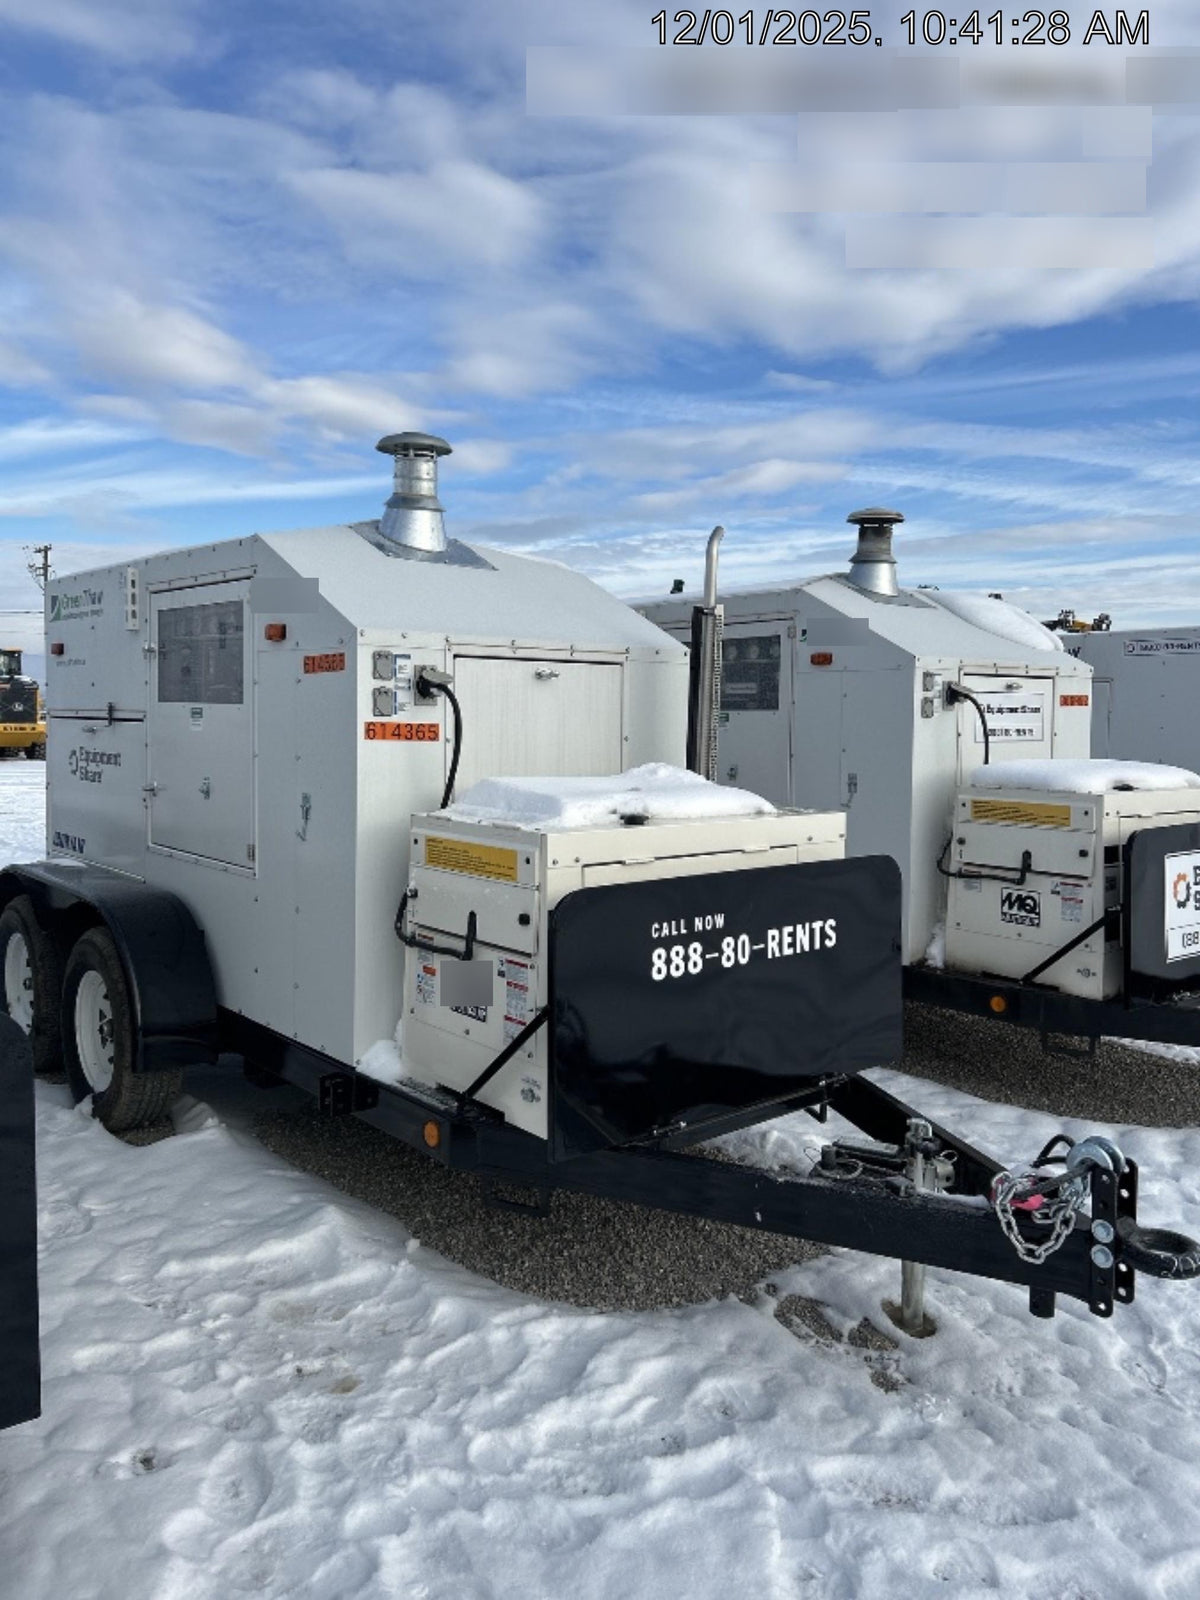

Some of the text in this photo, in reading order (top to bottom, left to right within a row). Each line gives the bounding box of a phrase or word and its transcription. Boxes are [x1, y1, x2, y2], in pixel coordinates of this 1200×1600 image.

[367, 723, 438, 740] 614365
[1001, 892, 1039, 916] MQ
[652, 913, 725, 939] CALL NOW
[651, 918, 837, 981] 888-80-RENTS
